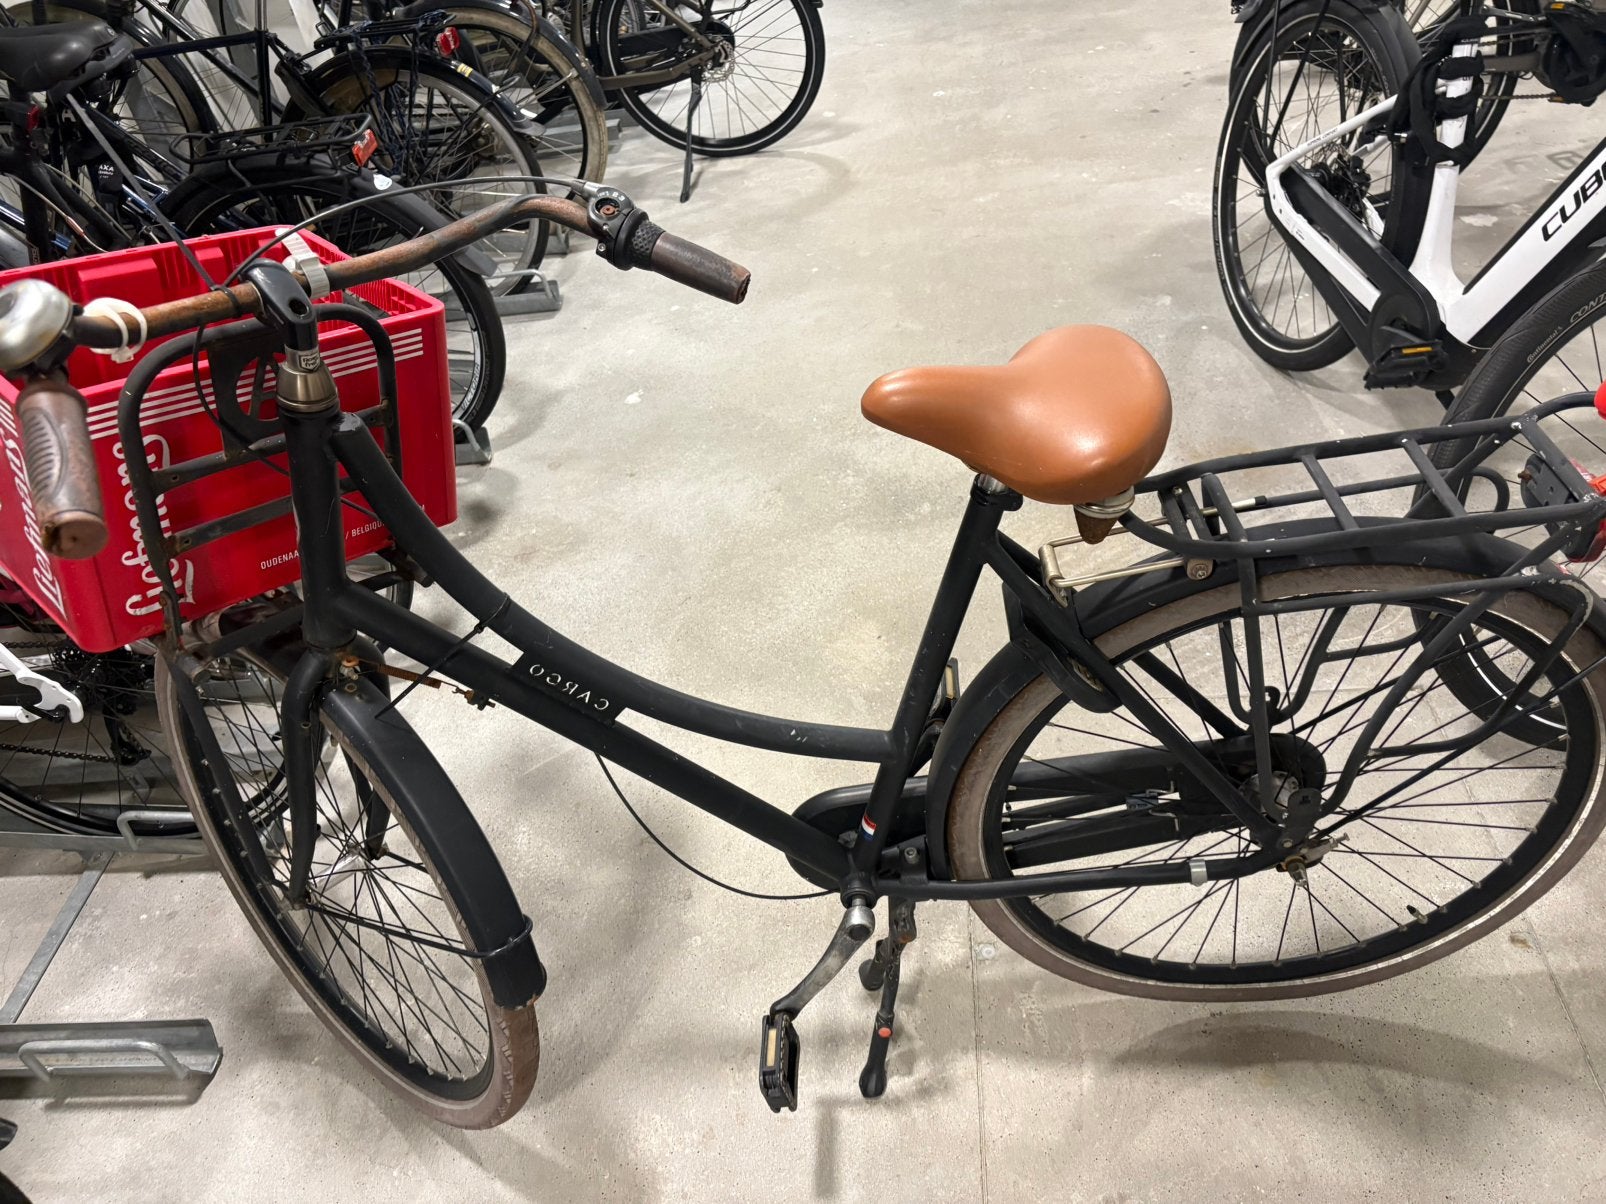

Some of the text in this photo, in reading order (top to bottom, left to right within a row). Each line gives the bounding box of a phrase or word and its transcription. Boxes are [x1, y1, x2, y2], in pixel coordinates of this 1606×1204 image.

[1541, 160, 1606, 242] CUB
[1569, 291, 1606, 323] CONT
[0, 428, 68, 621] Liefmans
[260, 549, 300, 570] OUDENAA
[351, 520, 385, 537] BELGIQU
